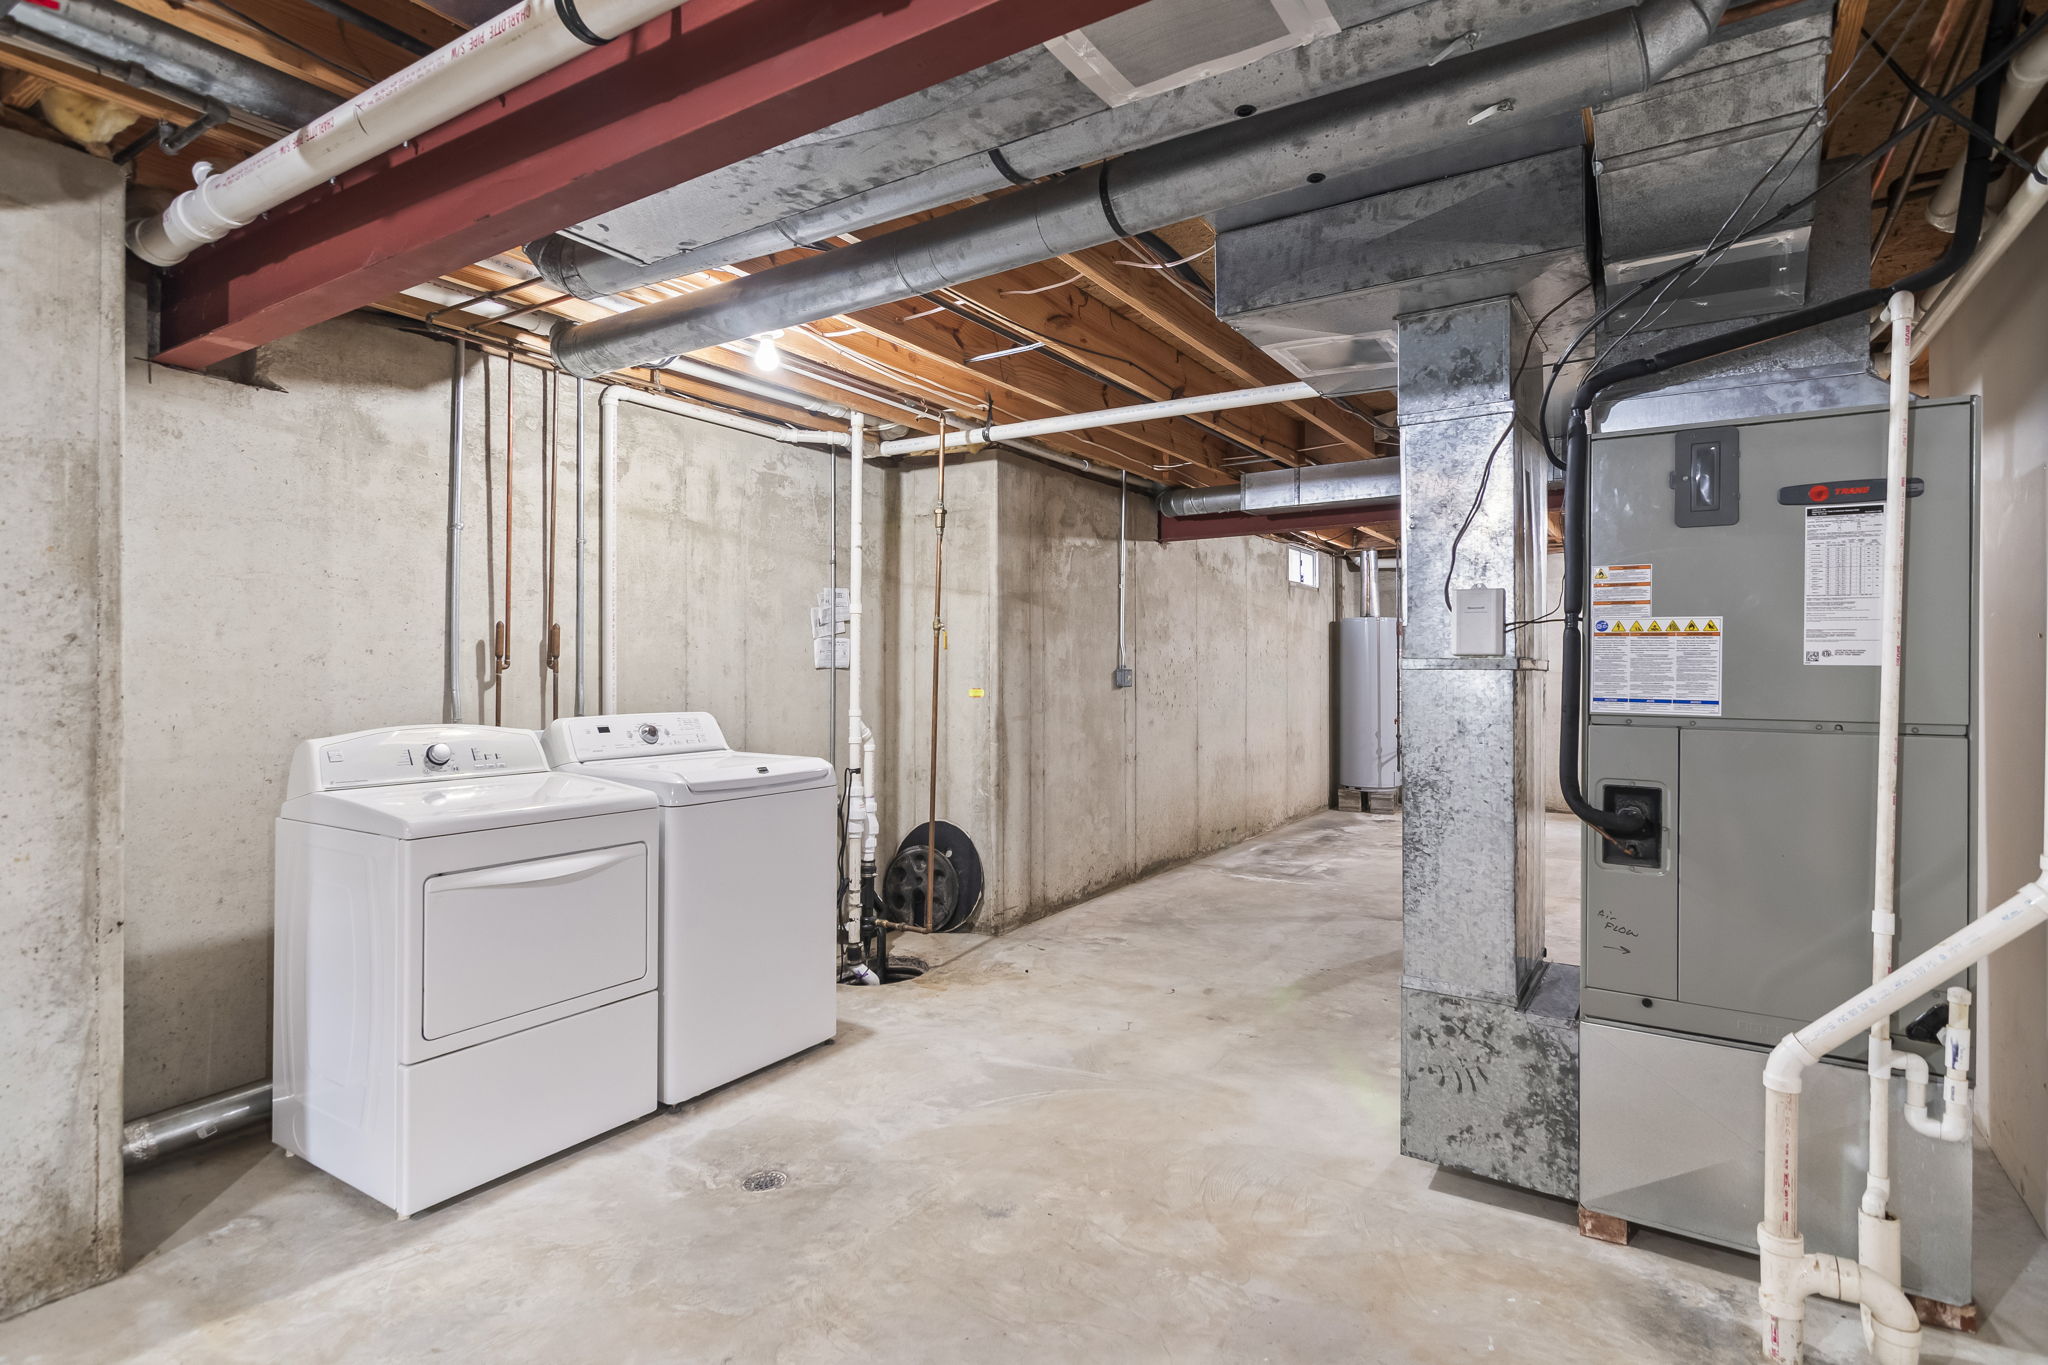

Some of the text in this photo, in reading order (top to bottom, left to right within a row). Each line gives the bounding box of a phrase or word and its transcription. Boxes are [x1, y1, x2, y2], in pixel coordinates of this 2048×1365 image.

[489, 4, 531, 39] CHARLOTTE
[469, 31, 485, 50] PIPE
[1834, 486, 1871, 495] TRANE
